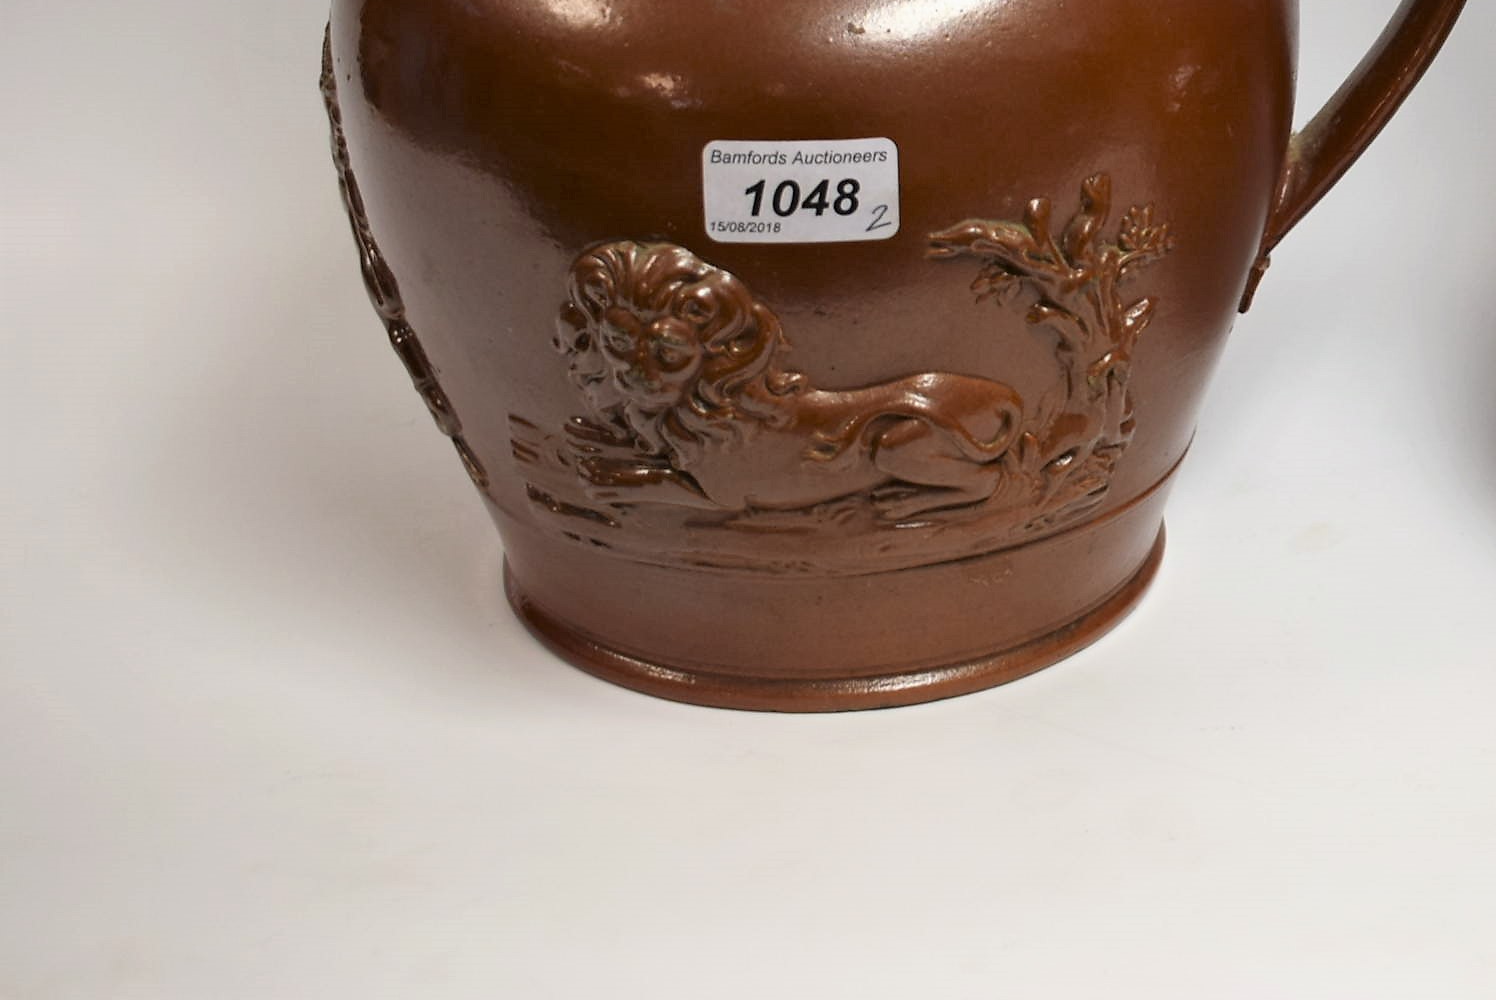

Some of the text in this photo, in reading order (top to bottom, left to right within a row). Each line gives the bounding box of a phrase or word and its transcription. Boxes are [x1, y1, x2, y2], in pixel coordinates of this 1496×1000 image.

[710, 149, 888, 165] Bamfords Auctioneers
[744, 178, 861, 217] 1048
[710, 221, 781, 233] 15/08/2018
[865, 204, 892, 232] 2
